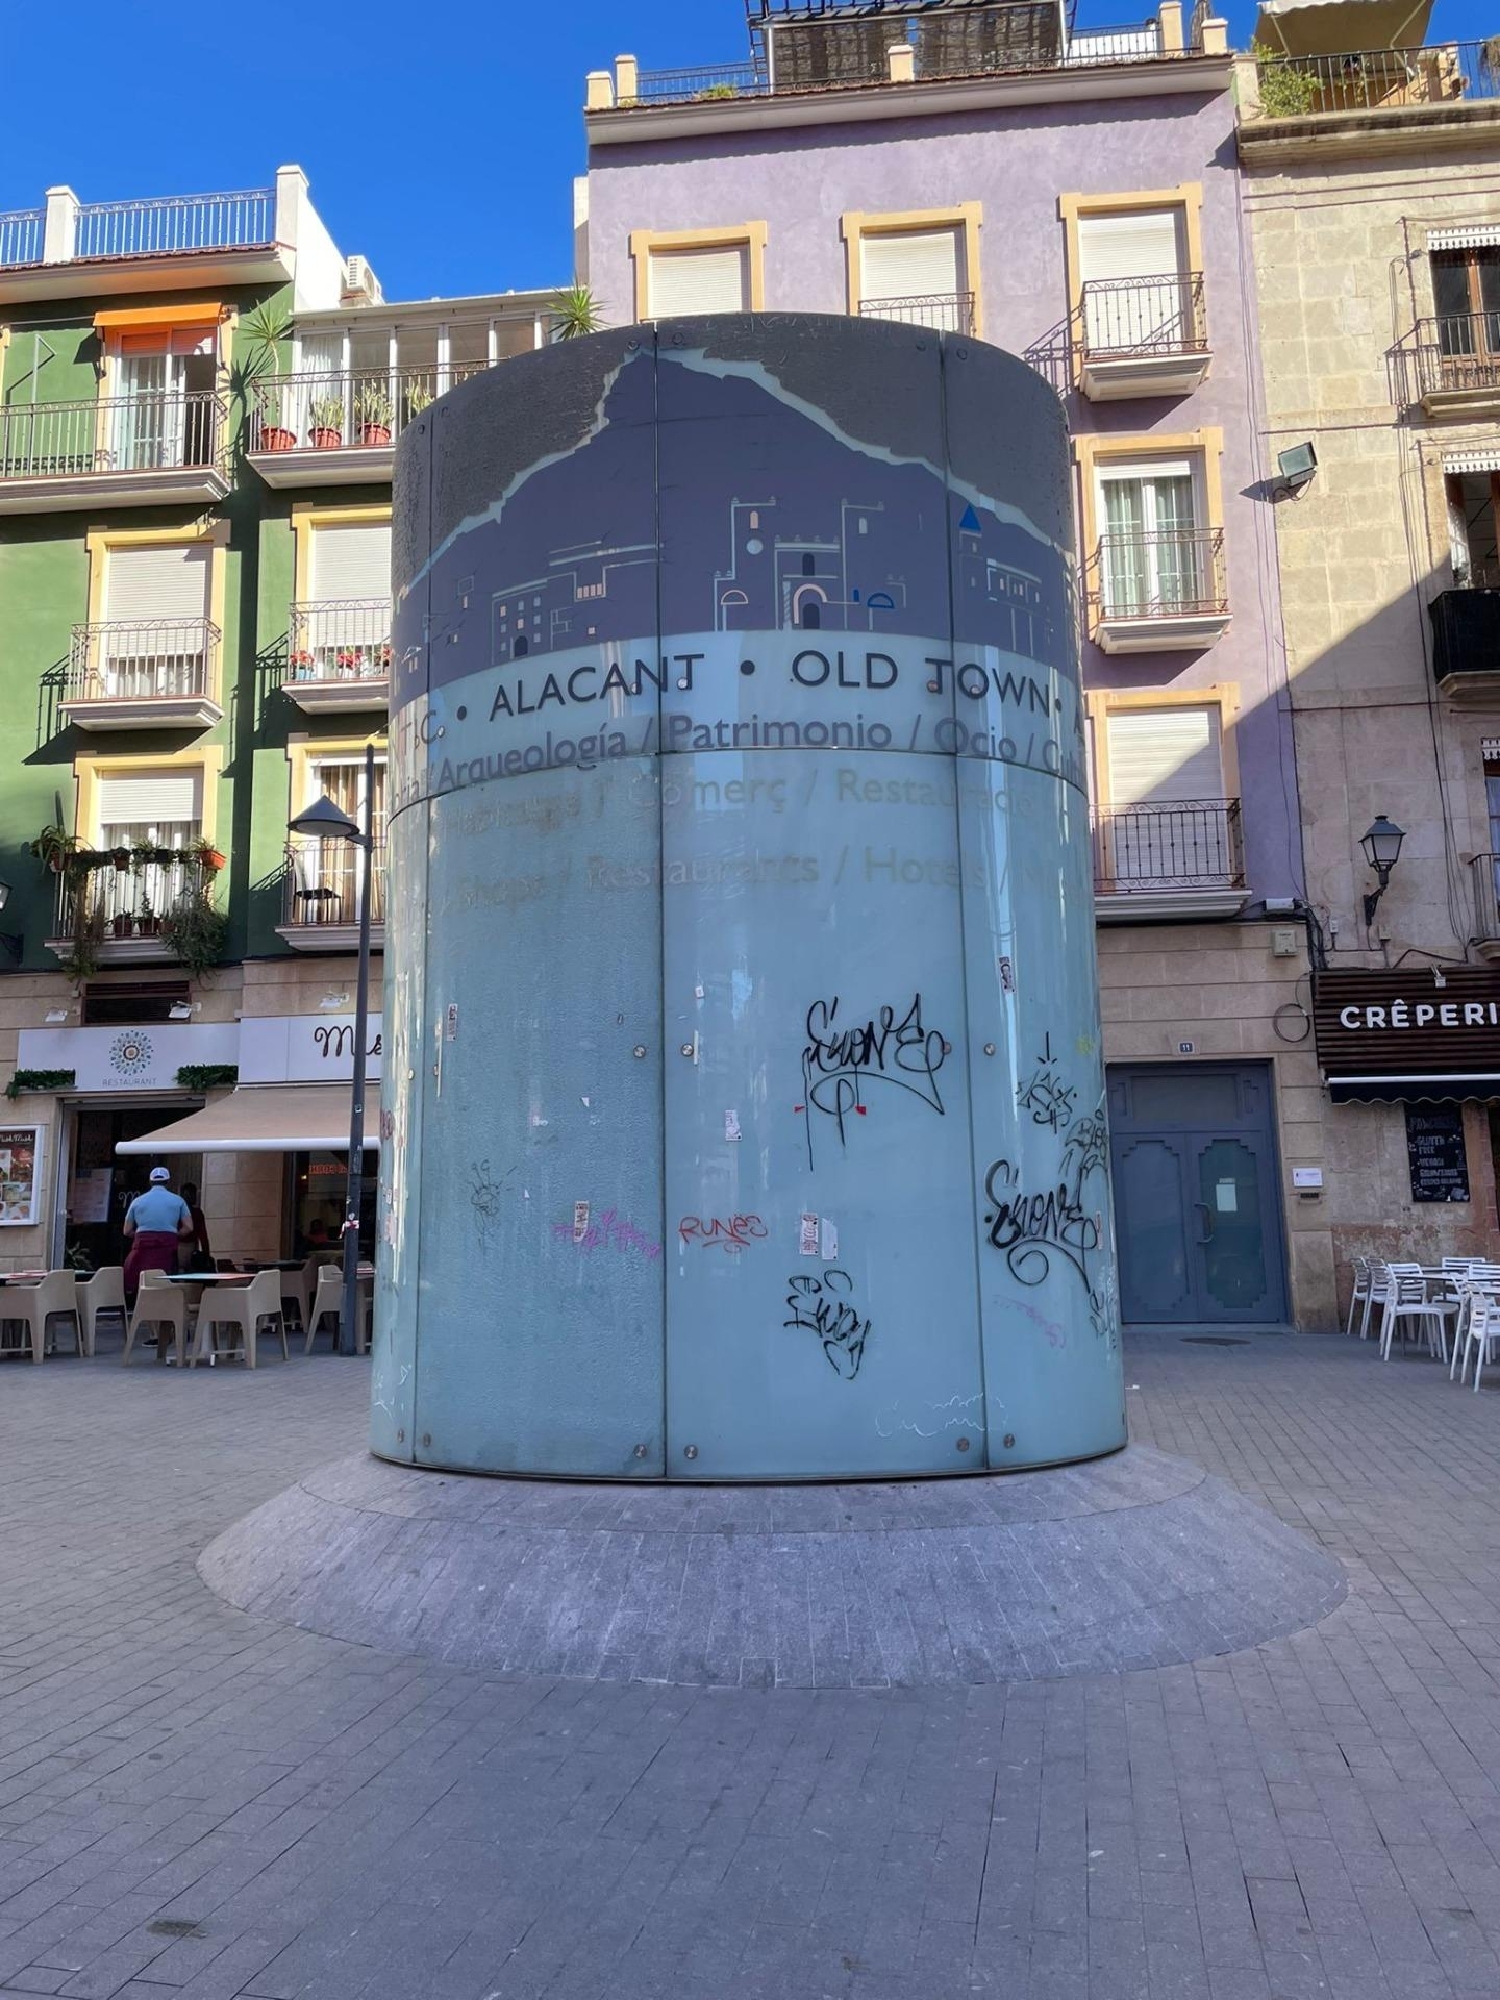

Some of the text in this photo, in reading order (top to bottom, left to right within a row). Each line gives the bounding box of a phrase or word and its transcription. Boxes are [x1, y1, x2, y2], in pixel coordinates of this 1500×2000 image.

[489, 653, 705, 722] ALACANT
[792, 650, 898, 688] OLD
[925, 657, 1050, 718] TOWN
[437, 722, 628, 790] Arqueología
[669, 714, 892, 749] Patrimonio
[933, 717, 1017, 761] Ocio
[1340, 999, 1498, 1028] CRÊPERI
[314, 1025, 382, 1057] Ms
[102, 1078, 158, 1086] RESTAURANT
